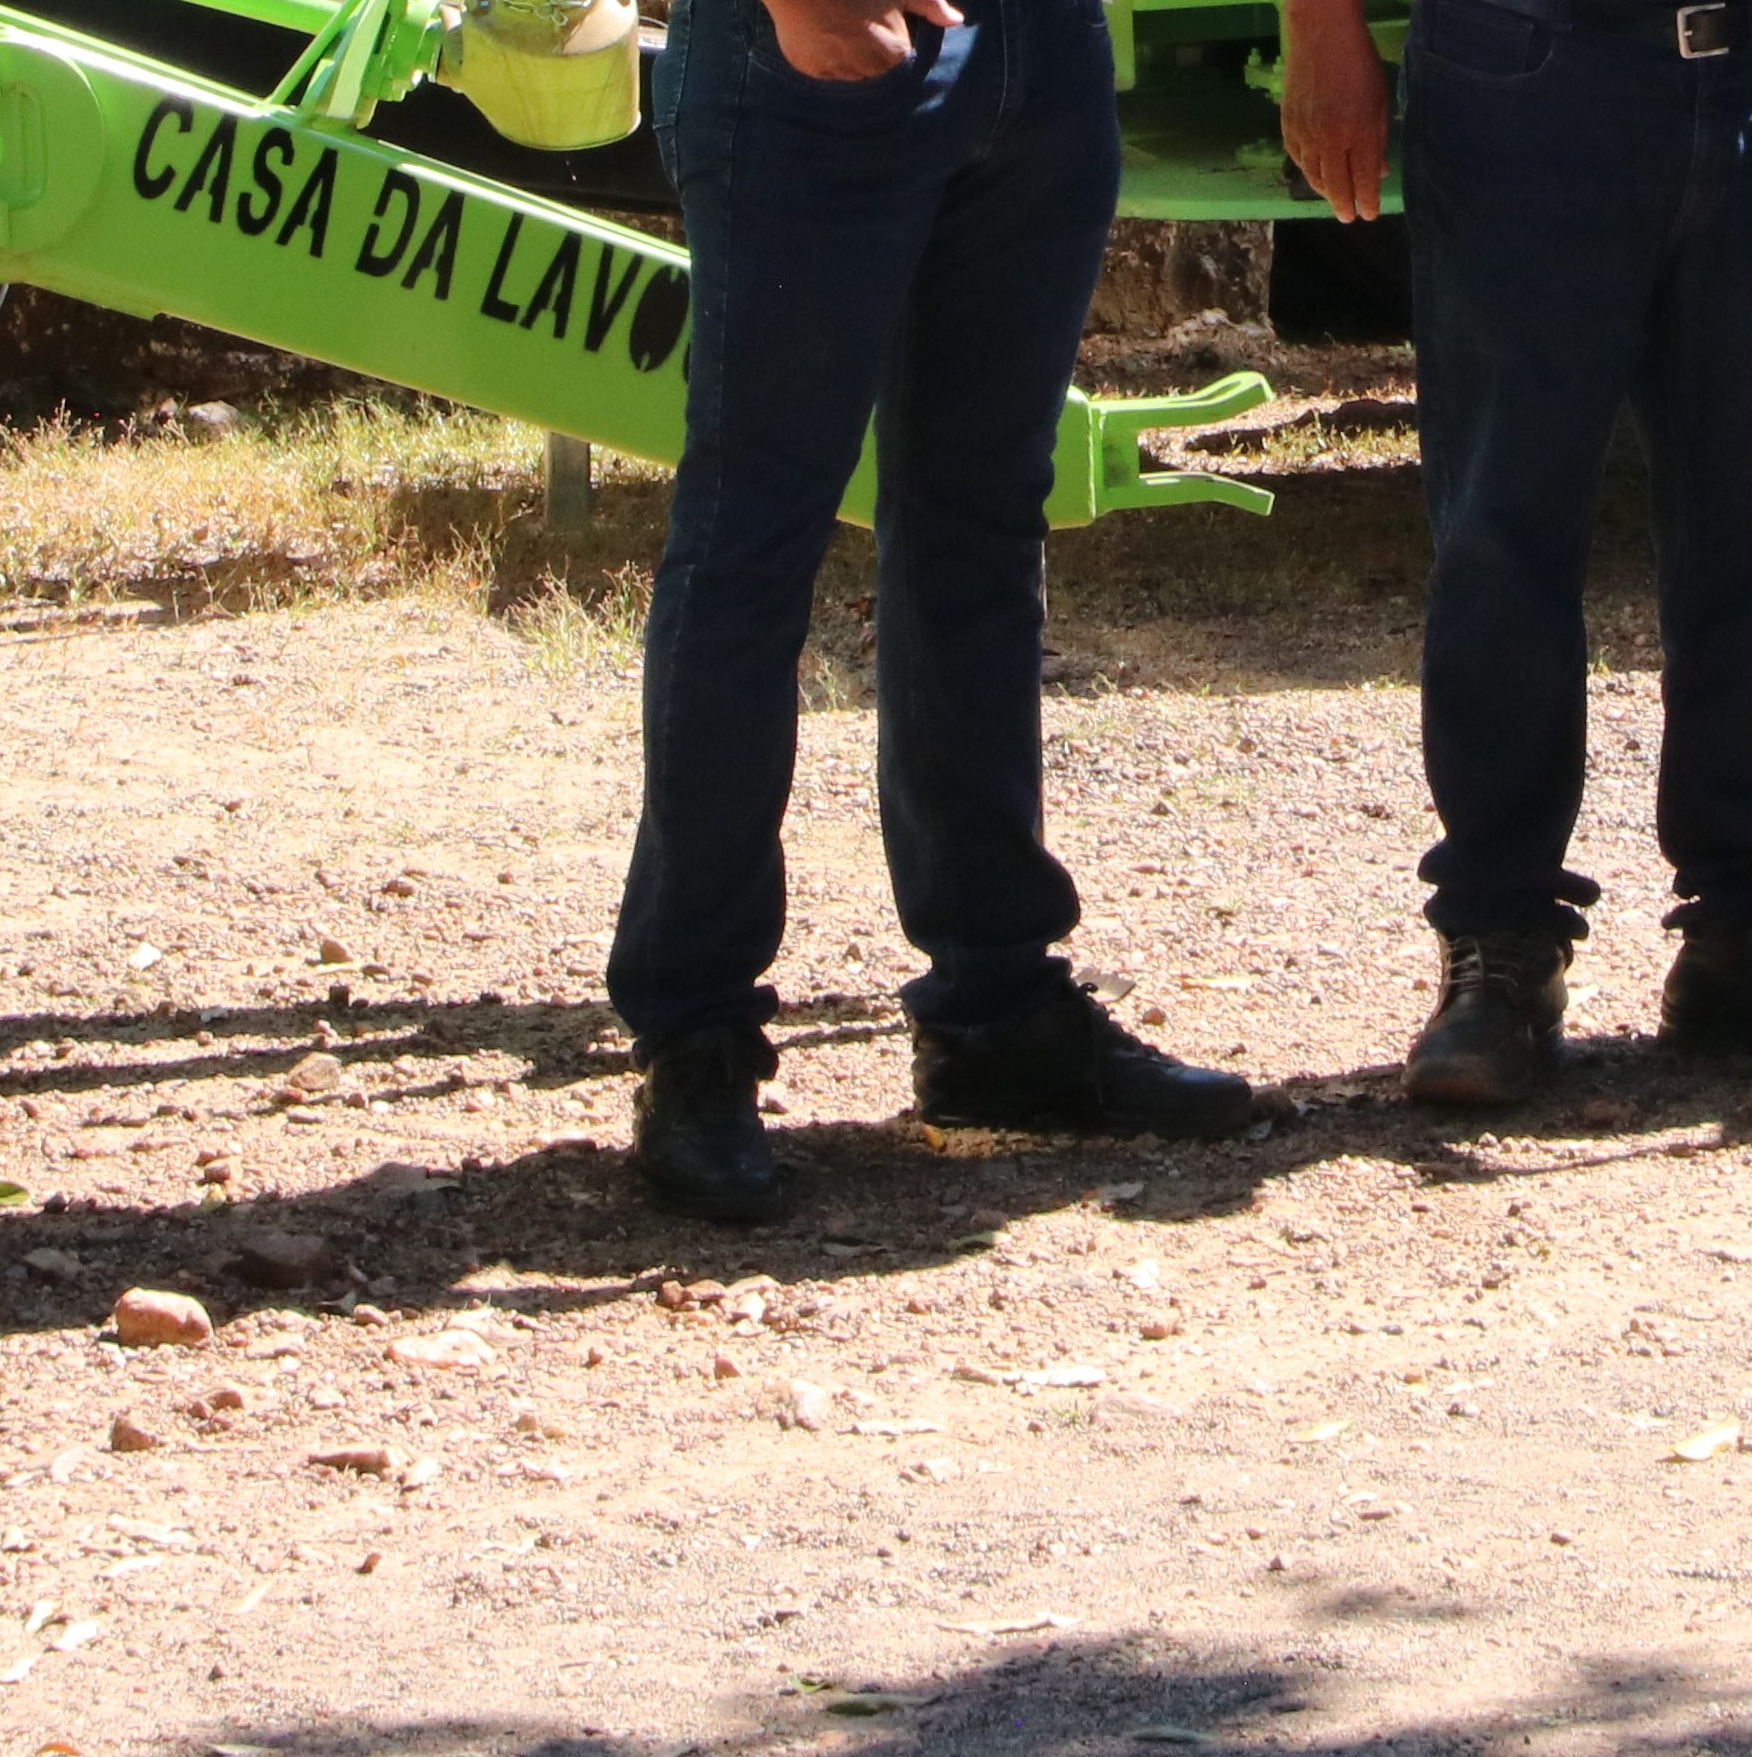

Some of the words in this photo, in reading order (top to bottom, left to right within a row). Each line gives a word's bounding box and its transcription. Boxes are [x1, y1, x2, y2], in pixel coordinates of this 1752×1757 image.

[133, 97, 339, 259] CASA
[354, 168, 467, 302] DA
[479, 210, 692, 386] LAVO
